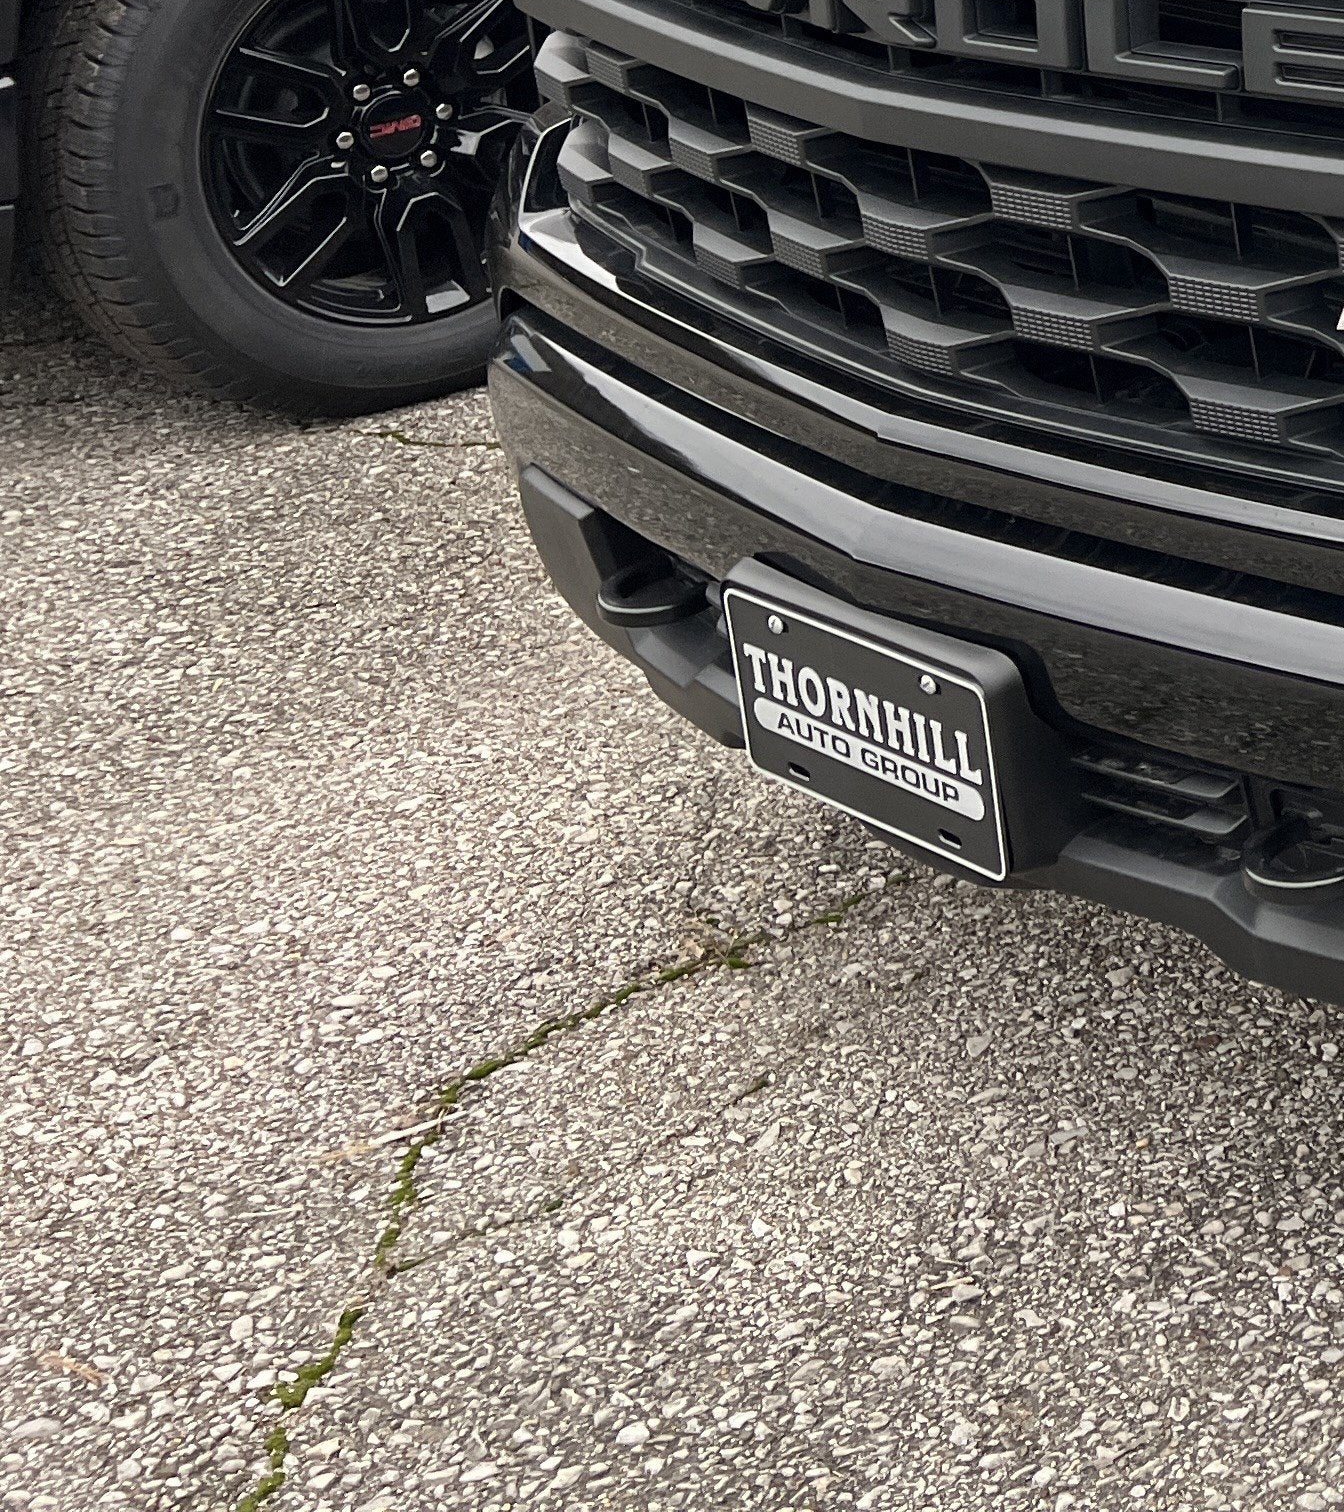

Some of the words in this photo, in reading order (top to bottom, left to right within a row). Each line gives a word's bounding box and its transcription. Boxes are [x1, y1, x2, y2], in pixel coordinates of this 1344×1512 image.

[743, 642, 984, 786] THORNHILL
[777, 711, 851, 759] AUTO
[860, 748, 960, 804] GROUP
